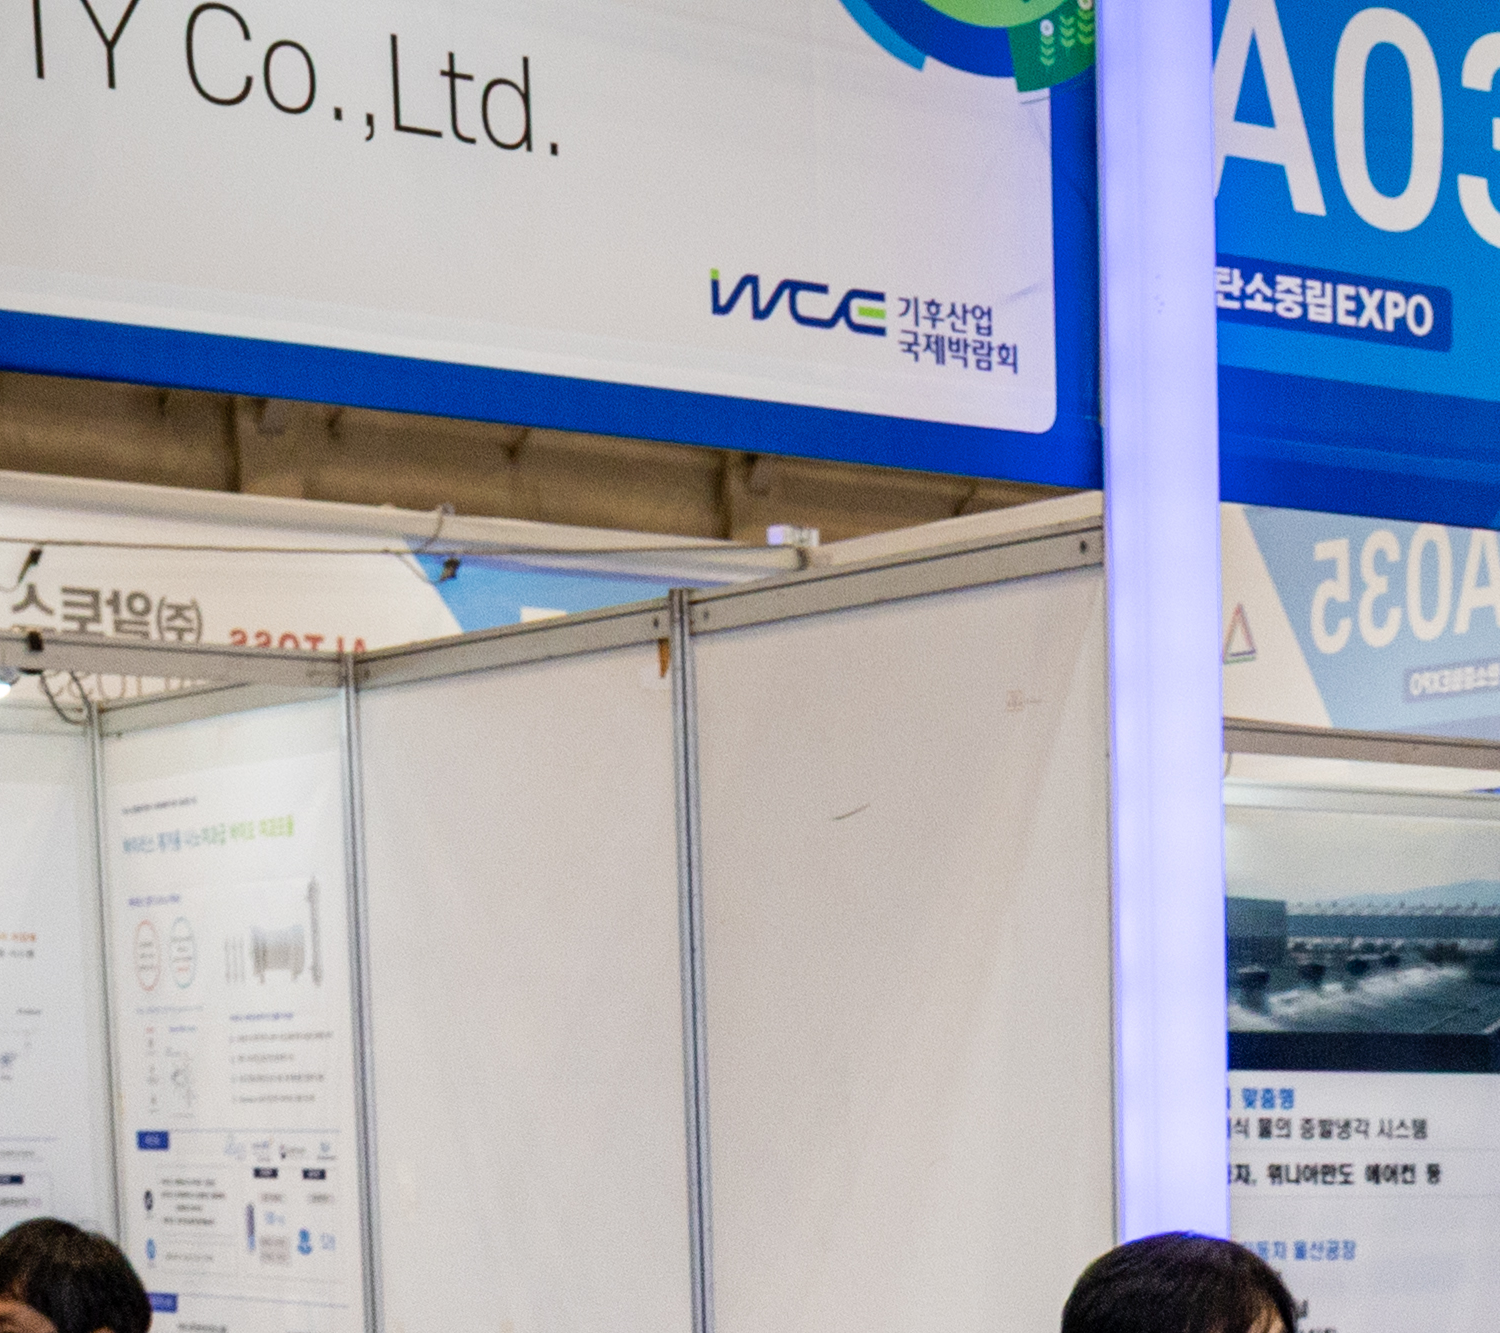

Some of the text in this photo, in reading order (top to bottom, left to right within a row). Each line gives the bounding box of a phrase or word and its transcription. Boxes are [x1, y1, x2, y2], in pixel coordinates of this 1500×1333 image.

[184, 2, 559, 155] Co.,Ltd.
[898, 297, 993, 336] 기후산업
[1215, 265, 1434, 337] 탄소중립EXPO
[898, 329, 1018, 374] 국제박람회
[1378, 1118, 1427, 1140] 시스템
